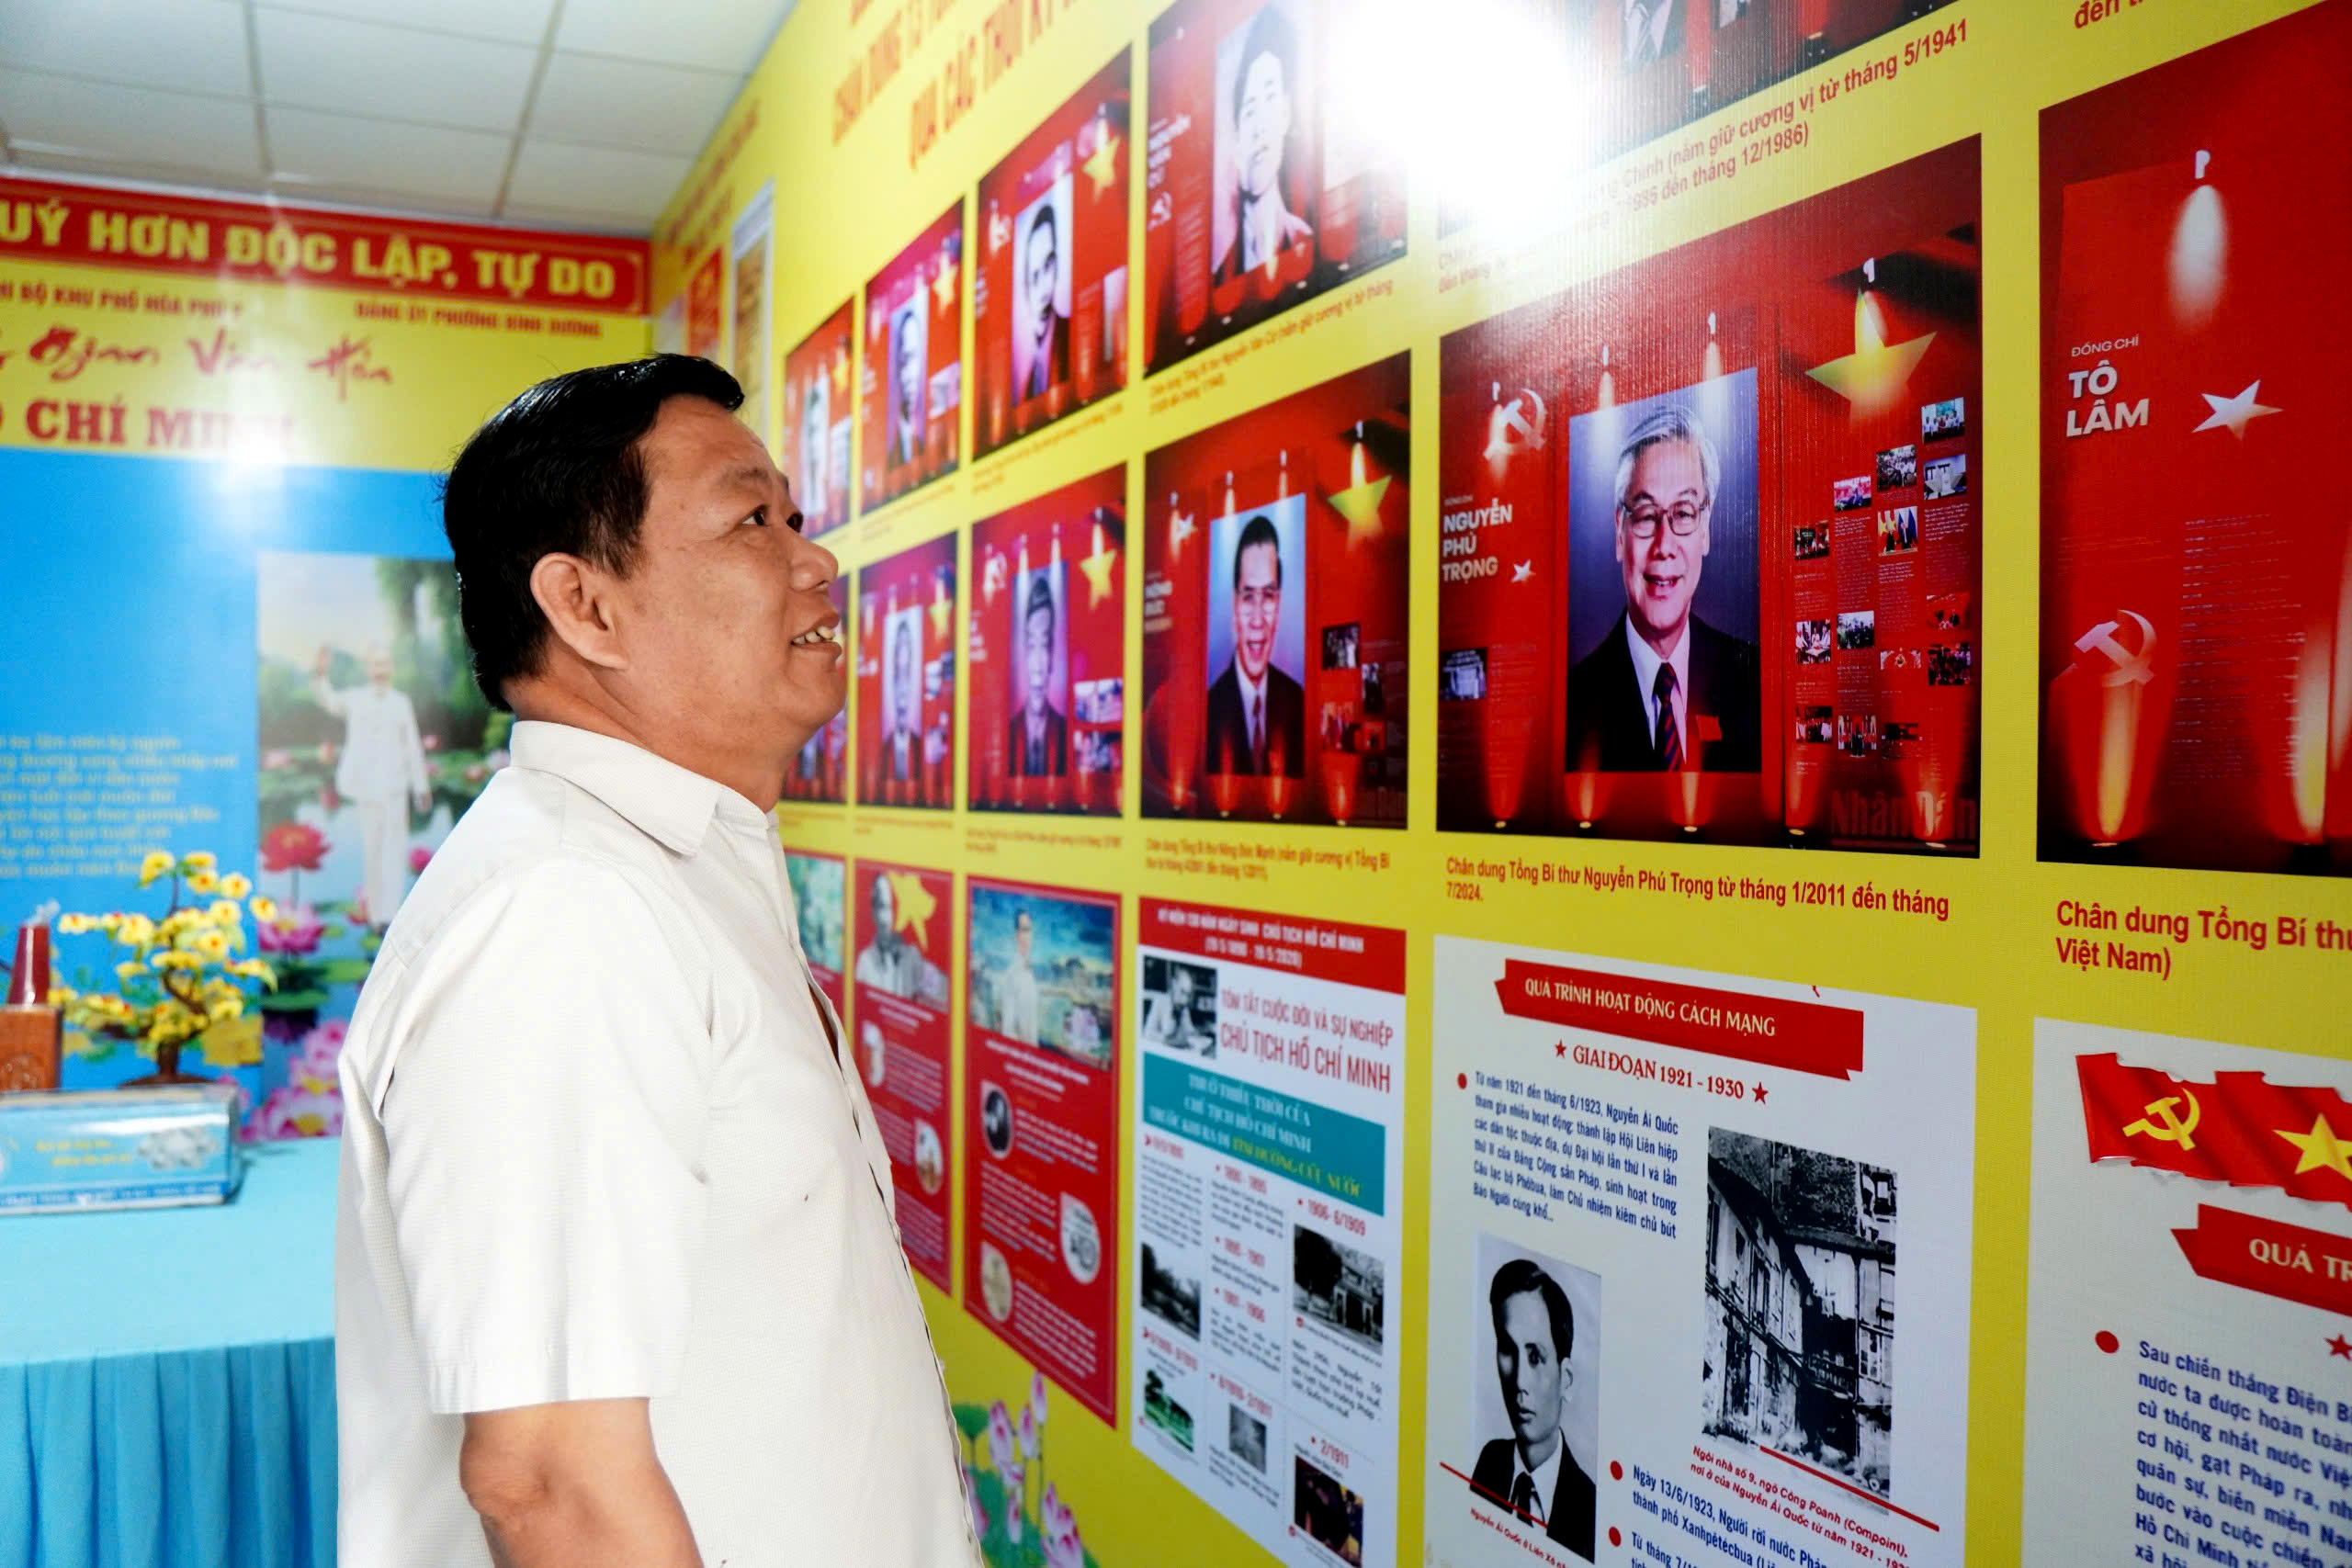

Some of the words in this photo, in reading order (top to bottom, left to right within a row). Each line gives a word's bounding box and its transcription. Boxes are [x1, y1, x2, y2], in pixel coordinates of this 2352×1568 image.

[1739, 100, 1795, 138] cương
[1799, 87, 1815, 113] vị
[1819, 78, 1840, 104] từ
[1844, 55, 1897, 93] tháng
[1904, 18, 1967, 66] 5/1941
[1692, 156, 1736, 187] tháng
[1741, 120, 1809, 165] 12/1986)
[89, 209, 209, 261] HƠN
[548, 257, 615, 298] DO
[2114, 334, 2140, 350] CHÍ
[2068, 359, 2118, 400] TÔ
[26, 395, 127, 446] CHÍ
[2066, 398, 2150, 438] LÂM
[1443, 498, 1513, 534] NGUYỄN
[1442, 533, 1477, 558] PHÚ
[1442, 557, 1498, 584] TRỌNG
[1446, 857, 1475, 876] Chân
[1477, 860, 1506, 883] dung
[1509, 858, 1539, 886] Tổng
[1542, 863, 1555, 883] Bí
[1558, 865, 1581, 885] thư
[1583, 865, 1634, 893] Nguyễn
[1637, 869, 1667, 892] Phú
[1670, 872, 1713, 901] Trọng
[1718, 875, 1736, 897] từ
[1739, 877, 1787, 908] tháng
[1792, 880, 1846, 908] 1/2011
[1851, 881, 1887, 911] đến
[1893, 888, 1950, 922] tháng
[2056, 900, 2118, 931] Chân
[2125, 906, 2189, 943] dung
[2198, 905, 2267, 951] Tổng
[2277, 916, 2306, 947] Bí
[2055, 937, 2100, 972] Việt
[2107, 942, 2172, 981] Nam)
[1525, 977, 1551, 998] QUÁ
[1555, 982, 1591, 1006] TRÌNH
[1595, 993, 1631, 1012] HOẠT
[1634, 997, 1675, 1021] ĐỘNG
[1679, 1000, 1721, 1028] CÁCH
[1725, 1012, 1776, 1037] MẠNG
[1349, 1017, 1394, 1050] NGHIỆP
[1289, 1035, 1310, 1070] HỒ
[1315, 1044, 1341, 1079] CHÍ
[1347, 1055, 1391, 1094] MINH
[1573, 1044, 1606, 1069] GIAI
[1608, 1054, 1657, 1080] ĐOẠN
[1659, 1066, 1692, 1089] 1921
[1707, 1076, 1744, 1100] 1930
[1544, 1089, 1566, 1110] tháng
[1607, 1104, 1639, 1125] Nguyễn
[1643, 1112, 1652, 1128] Ái
[1655, 1113, 1679, 1135] Quốc
[1577, 1121, 1600, 1140] thành
[1602, 1127, 1616, 1145] lập
[1619, 1133, 1634, 1150] Hội
[1636, 1136, 1655, 1155] Liên
[1658, 1142, 1678, 1163] hiệp
[1591, 1148, 1604, 1165] hội
[1608, 1153, 1621, 1169] lần
[1624, 1156, 1639, 1175] thứ
[1648, 1167, 1659, 1181] và
[1663, 1168, 1678, 1187] lần
[1567, 1190, 1583, 1208] Chủ
[1587, 1197, 1611, 1217] nhiệm
[1615, 1205, 1636, 1225] kiêm
[1640, 1214, 1657, 1232] chủ
[1660, 1220, 1677, 1239] bút
[1606, 1178, 1623, 1195] sinh
[1627, 1184, 1647, 1204] hoạt
[1652, 1192, 1677, 1216] trong
[2249, 1236, 2314, 1273] QUÁ
[2139, 1339, 2170, 1366] Sau
[2175, 1353, 2222, 1382] chiến
[2227, 1368, 2279, 1404] thắng
[2286, 1385, 2329, 1417] Điện
[2138, 1371, 2178, 1397] nước
[2184, 1384, 2202, 1406] ta
[2209, 1393, 2251, 1423] được
[2258, 1407, 2304, 1440] hoàn
[2138, 1398, 2158, 1420] cử
[2164, 1408, 2212, 1443] thống
[2219, 1427, 2259, 1457] nhất
[2266, 1446, 2312, 1475] nước
[2320, 1459, 2352, 1490] Việ
[2138, 1429, 2156, 1449] cơ
[2201, 1452, 2232, 1477] gạt
[2239, 1462, 2286, 1498] Pháp
[1633, 1491, 1658, 1516] thành
[1662, 1503, 1679, 1527] phố
[1692, 1445, 1714, 1463] Ngôi
[1715, 1455, 1733, 1472] nhà
[1735, 1465, 1747, 1478] số
[1759, 1478, 1779, 1495] ngõ
[1780, 1488, 1807, 1509] Công
[1809, 1501, 1840, 1525] Poanh
[2137, 1458, 2177, 1485] quân
[2217, 1485, 2256, 1516] biến
[2264, 1506, 2311, 1538] miền
[1634, 1464, 1657, 1492] Ngày
[1719, 1509, 1748, 1537] Người
[1752, 1528, 1766, 1547] rời
[1770, 1539, 1796, 1562] nước
[1690, 1462, 1705, 1476] nơi
[1714, 1474, 1730, 1489] của
[1732, 1483, 1769, 1507] Nguyễn
[1770, 1498, 1781, 1514] Ái
[1783, 1508, 1809, 1529] Quốc
[1812, 1519, 1823, 1534] từ
[1824, 1528, 1847, 1546] năm
[1850, 1540, 1874, 1561] 1921
[2136, 1483, 2176, 1514] bước
[2183, 1504, 2213, 1529] vào
[2221, 1521, 2264, 1550] cuộc
[2272, 1539, 2324, 1568] chiến
[1632, 1531, 1643, 1551] Từ
[2135, 1513, 2157, 1536] Hồ
[2164, 1523, 2189, 1550] Chí
[2197, 1536, 2239, 1568] Minh
[2135, 1543, 2154, 1563] xã
